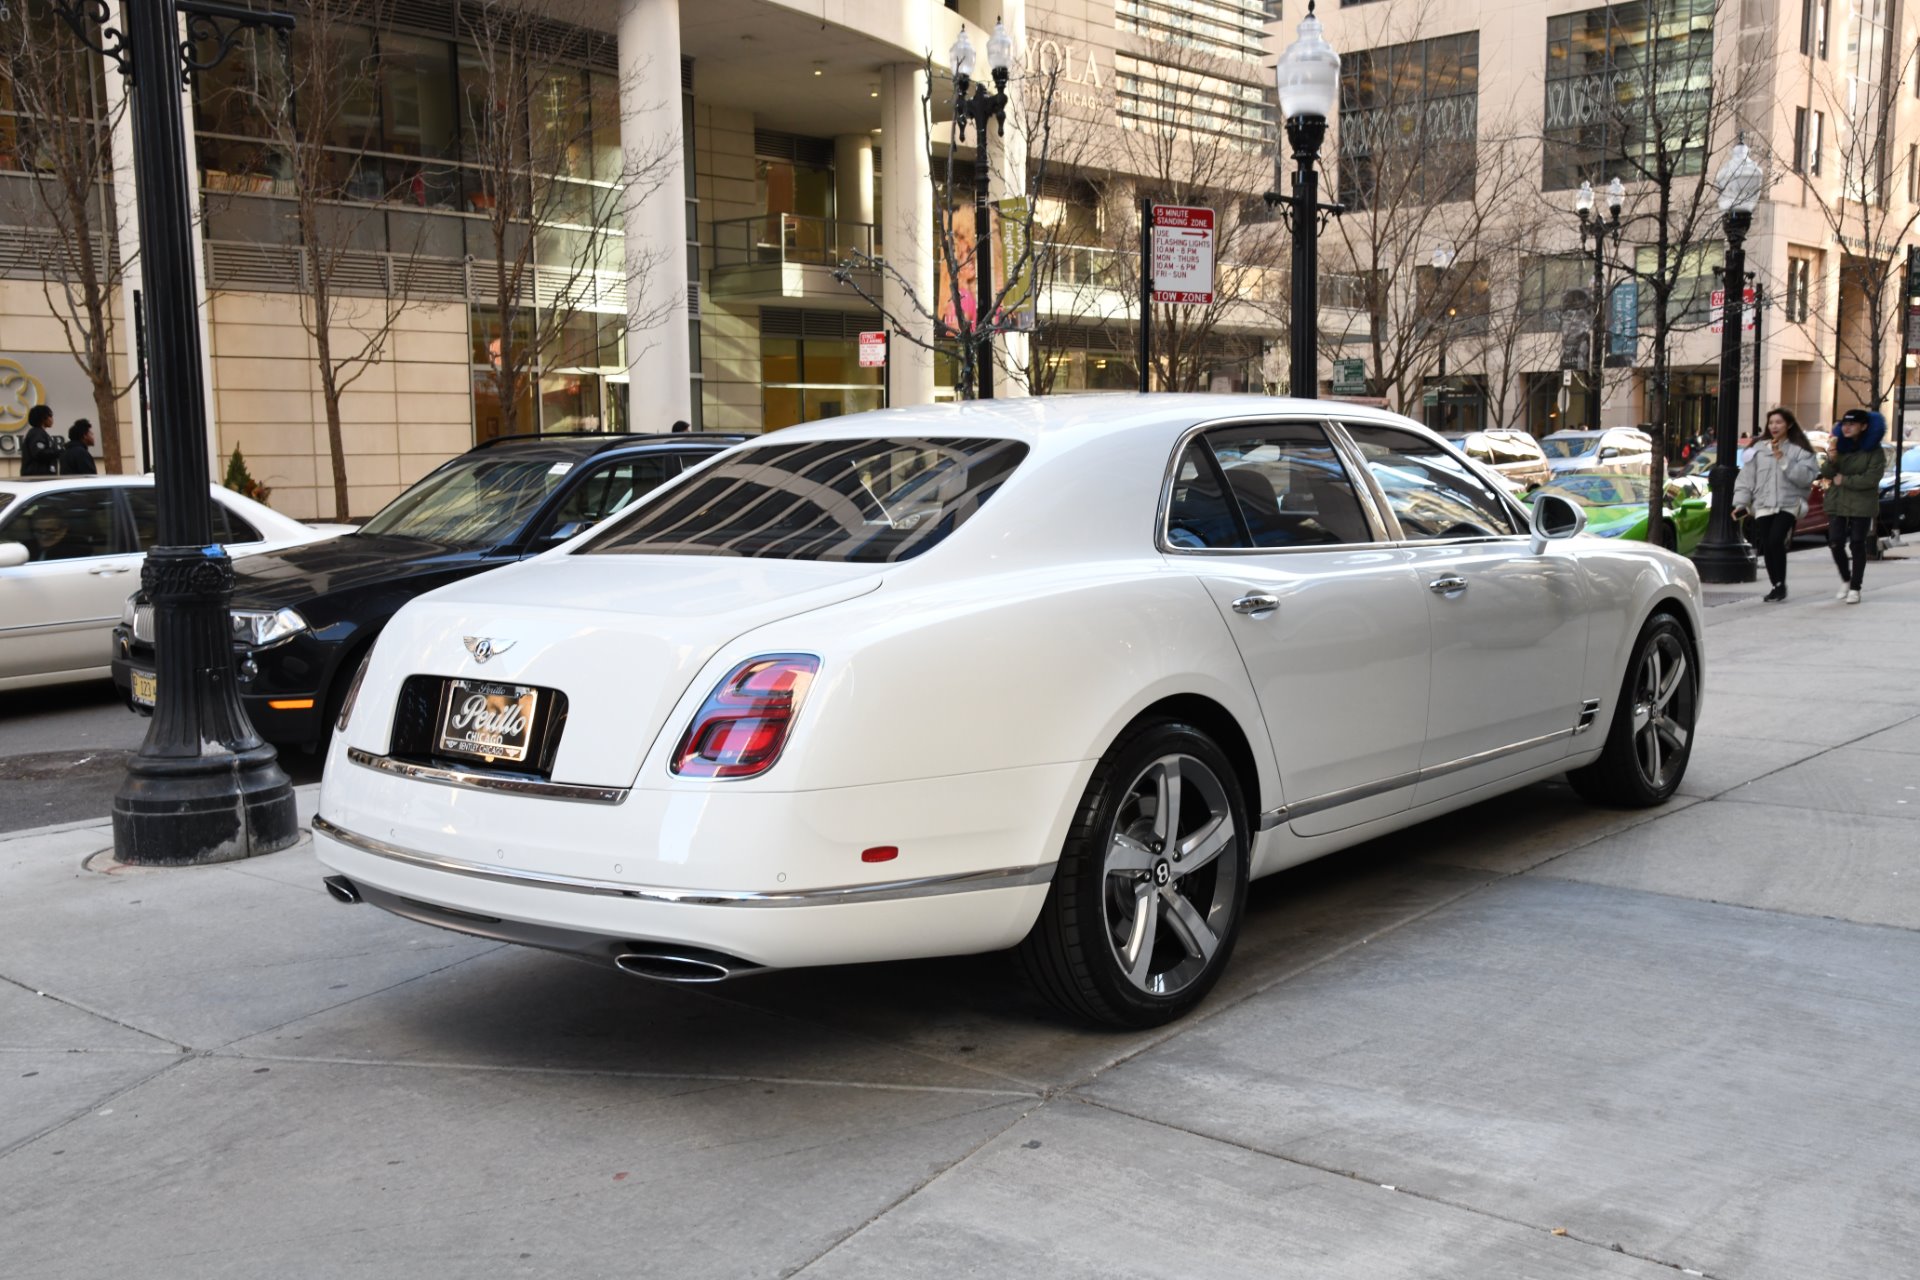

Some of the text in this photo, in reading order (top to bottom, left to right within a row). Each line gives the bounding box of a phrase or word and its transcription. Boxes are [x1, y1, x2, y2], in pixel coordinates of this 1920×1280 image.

[1157, 208, 1189, 218] 15 MINUTE
[1157, 217, 1208, 228] STANDING ZONE
[1156, 229, 1169, 238] USE
[1156, 238, 1211, 249] FLASHING LIGHTS
[1187, 247, 1197, 255] PM
[1156, 253, 1171, 262] MON
[1178, 254, 1200, 263] THURS
[1186, 263, 1196, 271] PM
[1156, 269, 1168, 277] FRI
[1173, 270, 1187, 278] SUN
[1155, 291, 1208, 303] TOW ZONE
[452, 694, 526, 737] Perillo
[466, 731, 503, 745] CHICAGO
[459, 742, 504, 756] BENTLEY CHICAGO
